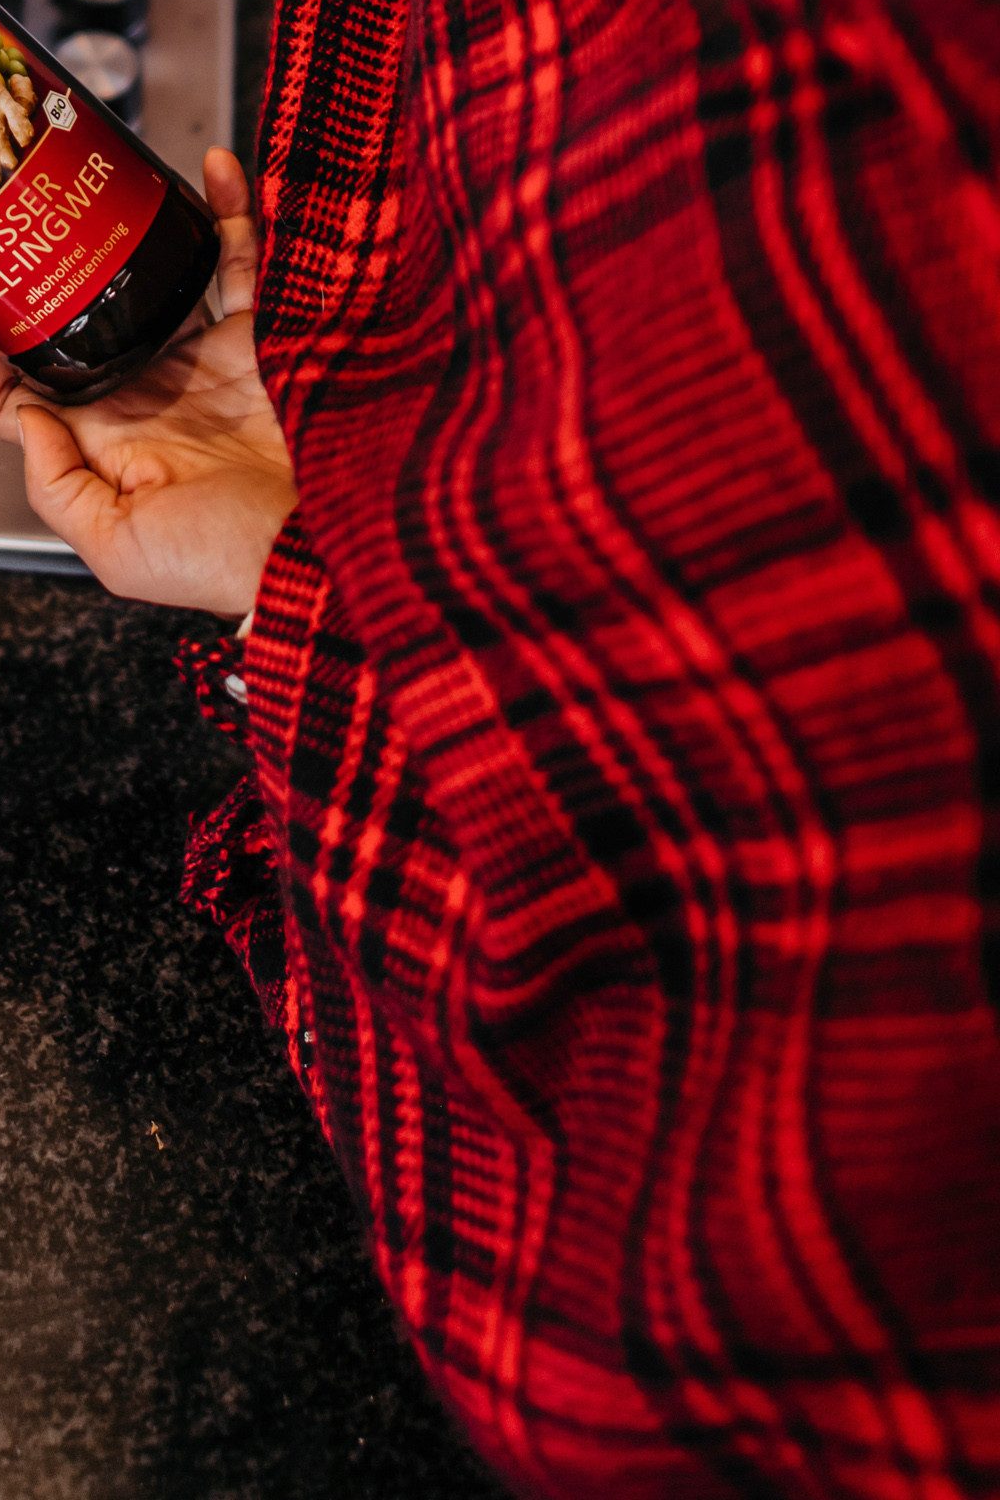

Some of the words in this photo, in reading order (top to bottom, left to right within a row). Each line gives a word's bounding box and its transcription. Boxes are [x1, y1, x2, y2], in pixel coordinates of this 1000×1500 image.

[10, 321, 31, 336] mit
[25, 221, 130, 326] Lindenblütenhonig
[25, 243, 88, 306] alkoholfrei
